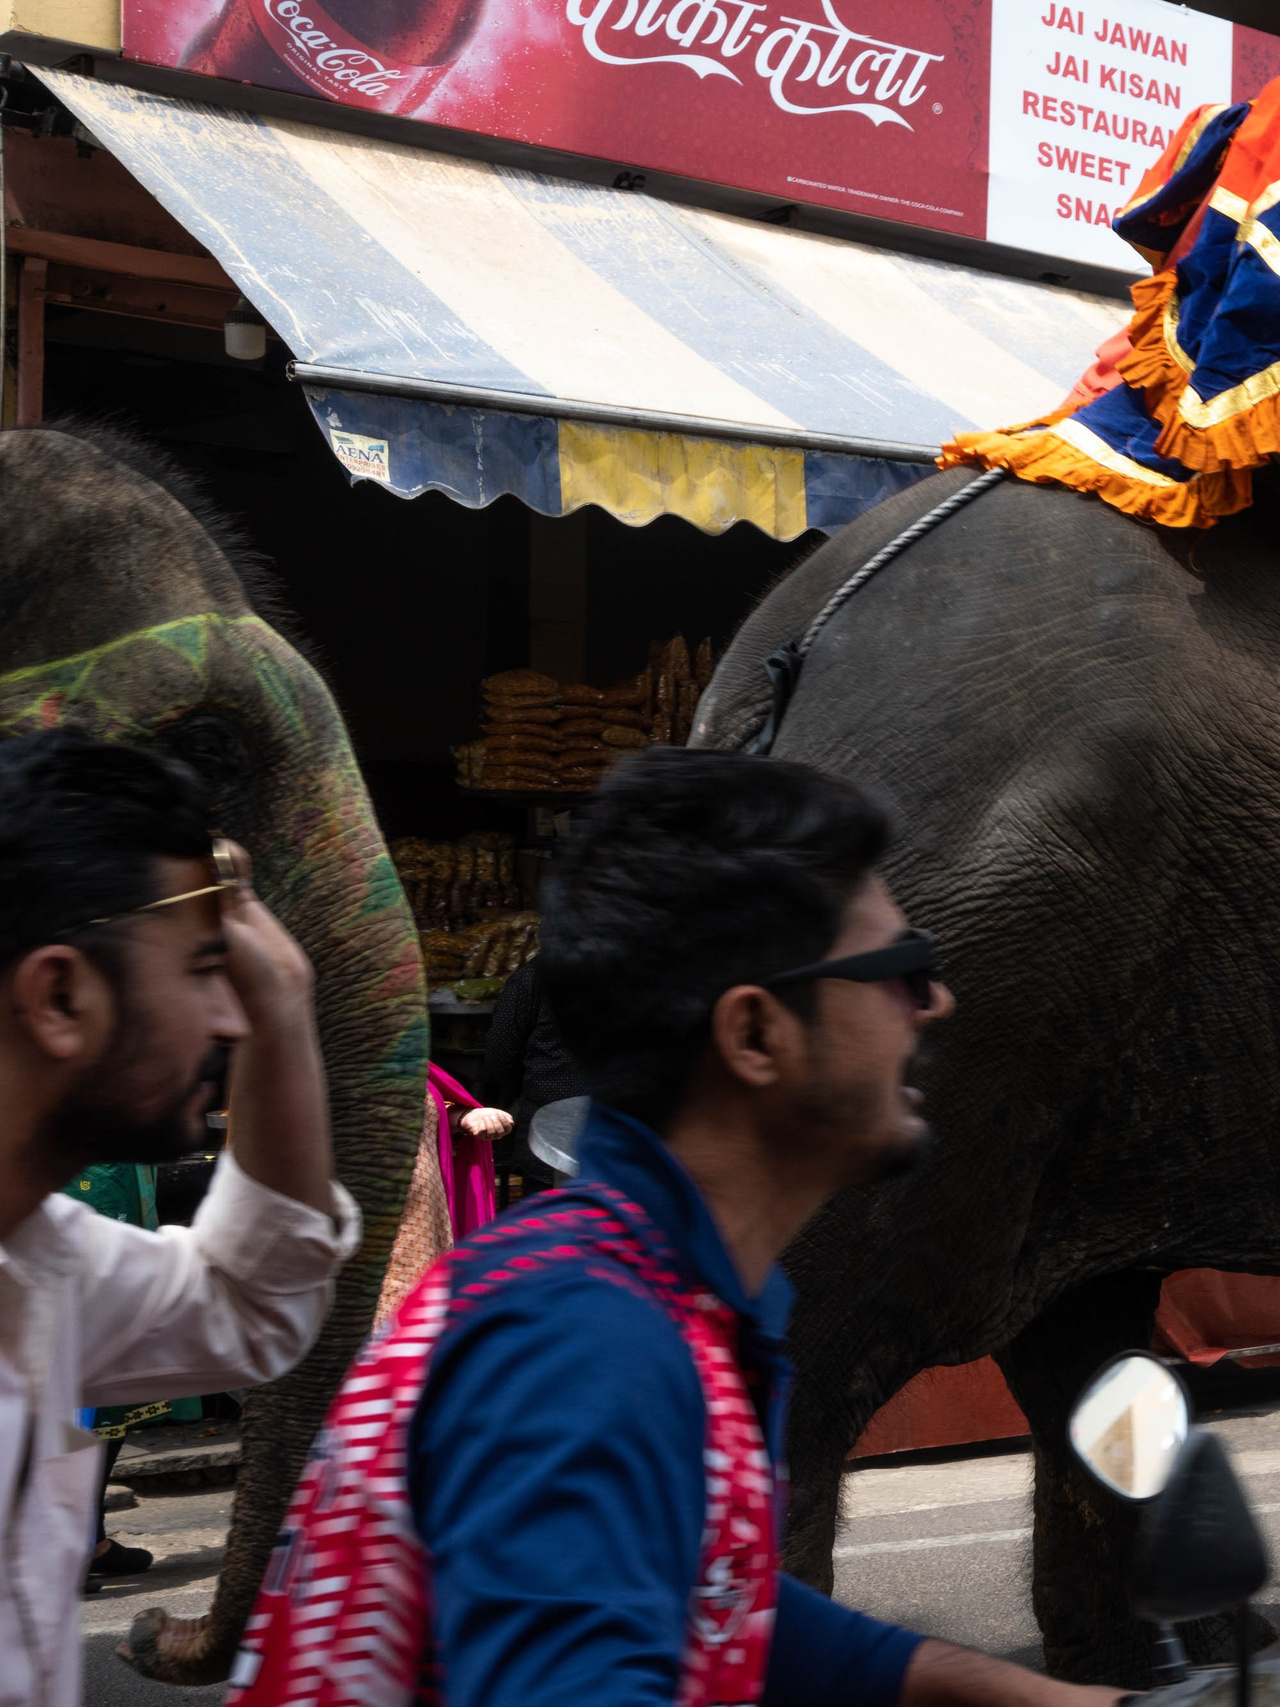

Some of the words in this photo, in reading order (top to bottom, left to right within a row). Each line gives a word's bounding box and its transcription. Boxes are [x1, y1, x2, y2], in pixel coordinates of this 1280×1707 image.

[1041, 2, 1084, 35] JAI
[1094, 19, 1188, 66] JAWAN
[286, 42, 322, 76] ORIGINAL
[324, 75, 350, 93] TASTE
[1046, 51, 1089, 84] JAI
[1100, 64, 1181, 109] KISAN
[1037, 141, 1131, 186] SWEET
[336, 444, 385, 464] AENA
